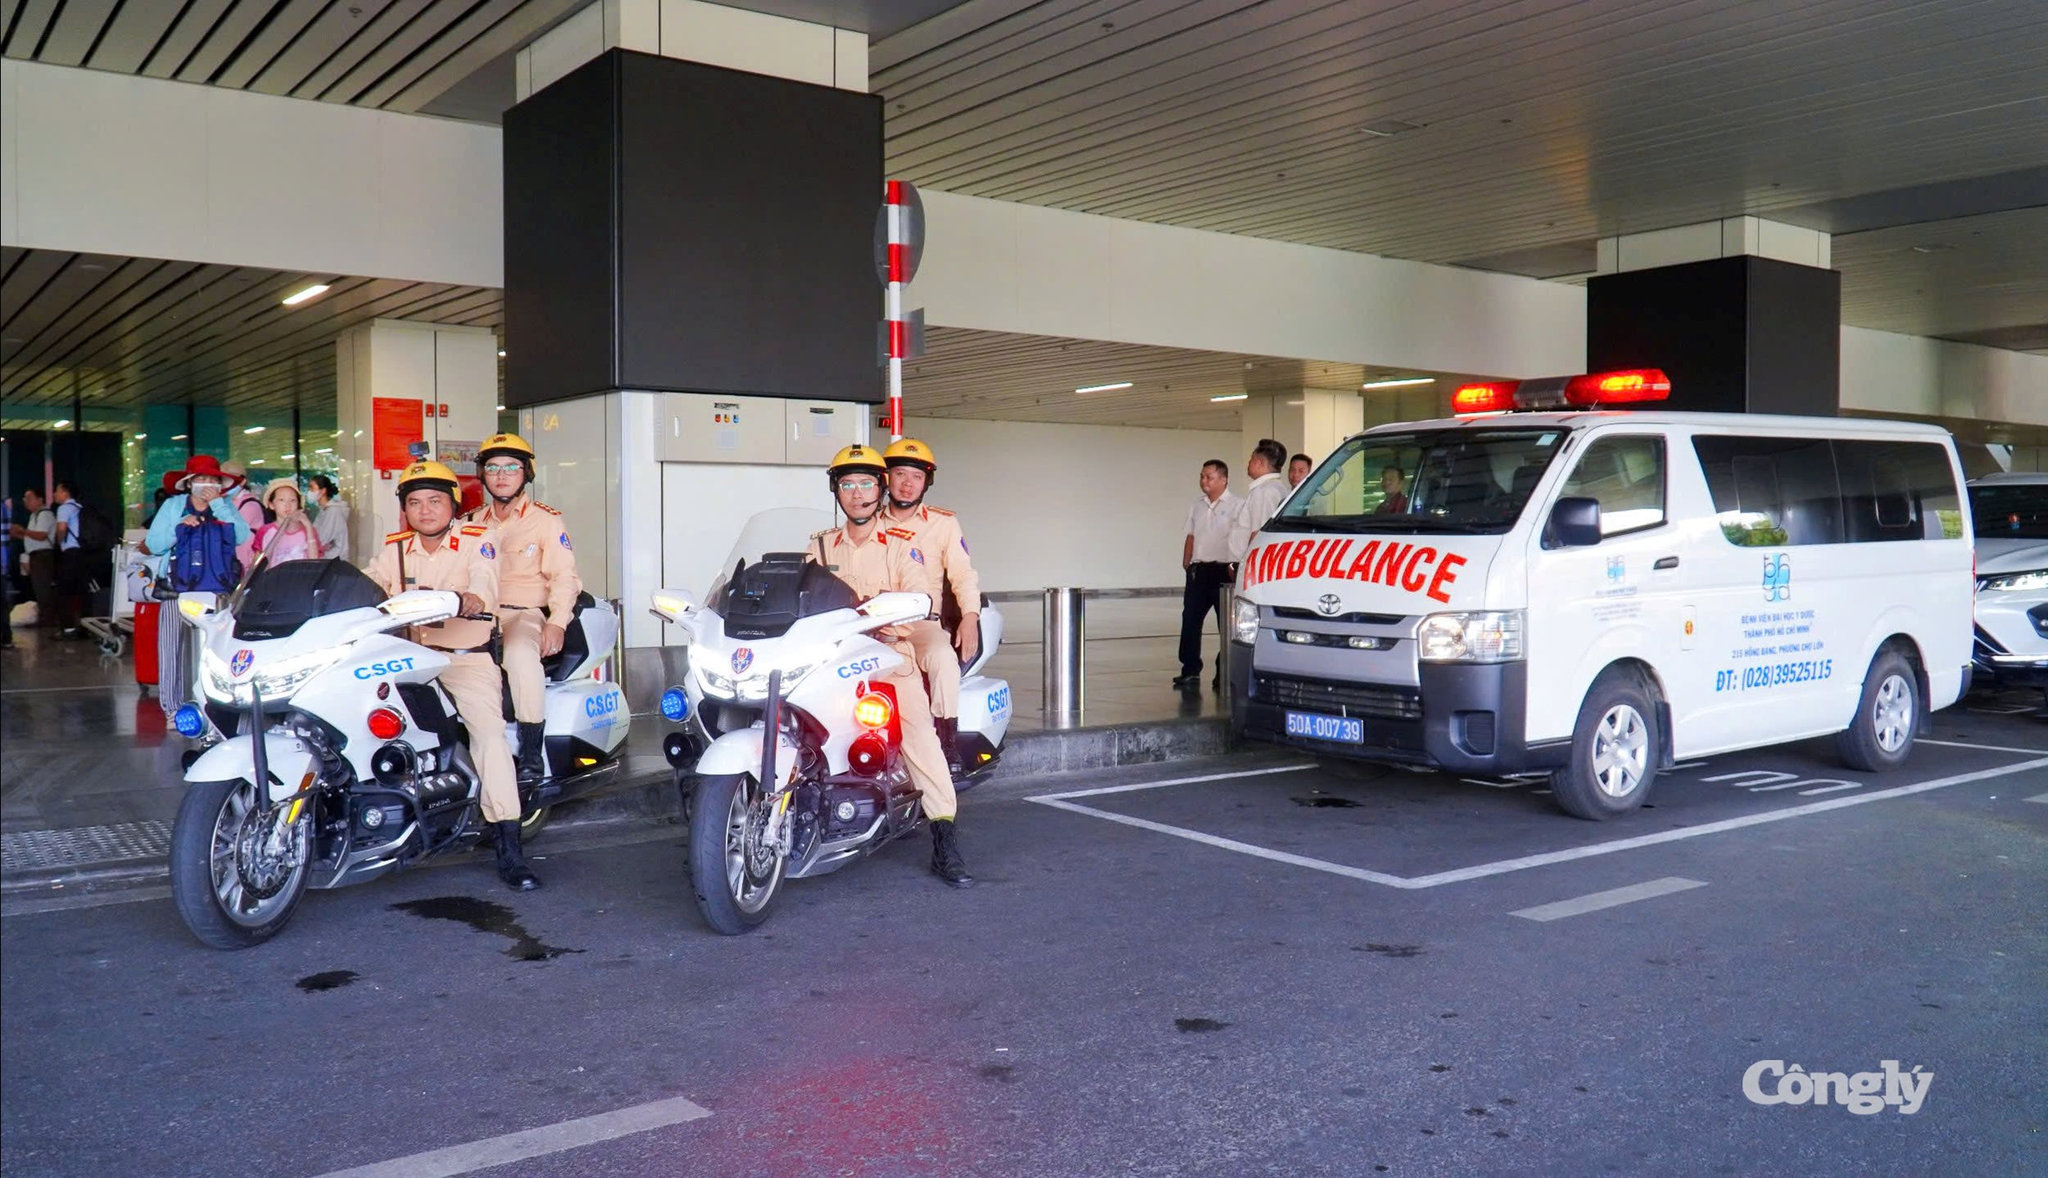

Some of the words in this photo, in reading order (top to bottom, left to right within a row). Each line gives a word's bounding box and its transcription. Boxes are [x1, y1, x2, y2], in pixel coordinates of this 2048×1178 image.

[1243, 538, 1468, 604] AMBULANCE
[1796, 624, 1810, 634] MINH
[1715, 668, 1738, 692] ĐT:
[1741, 658, 1833, 692] (028)39525115
